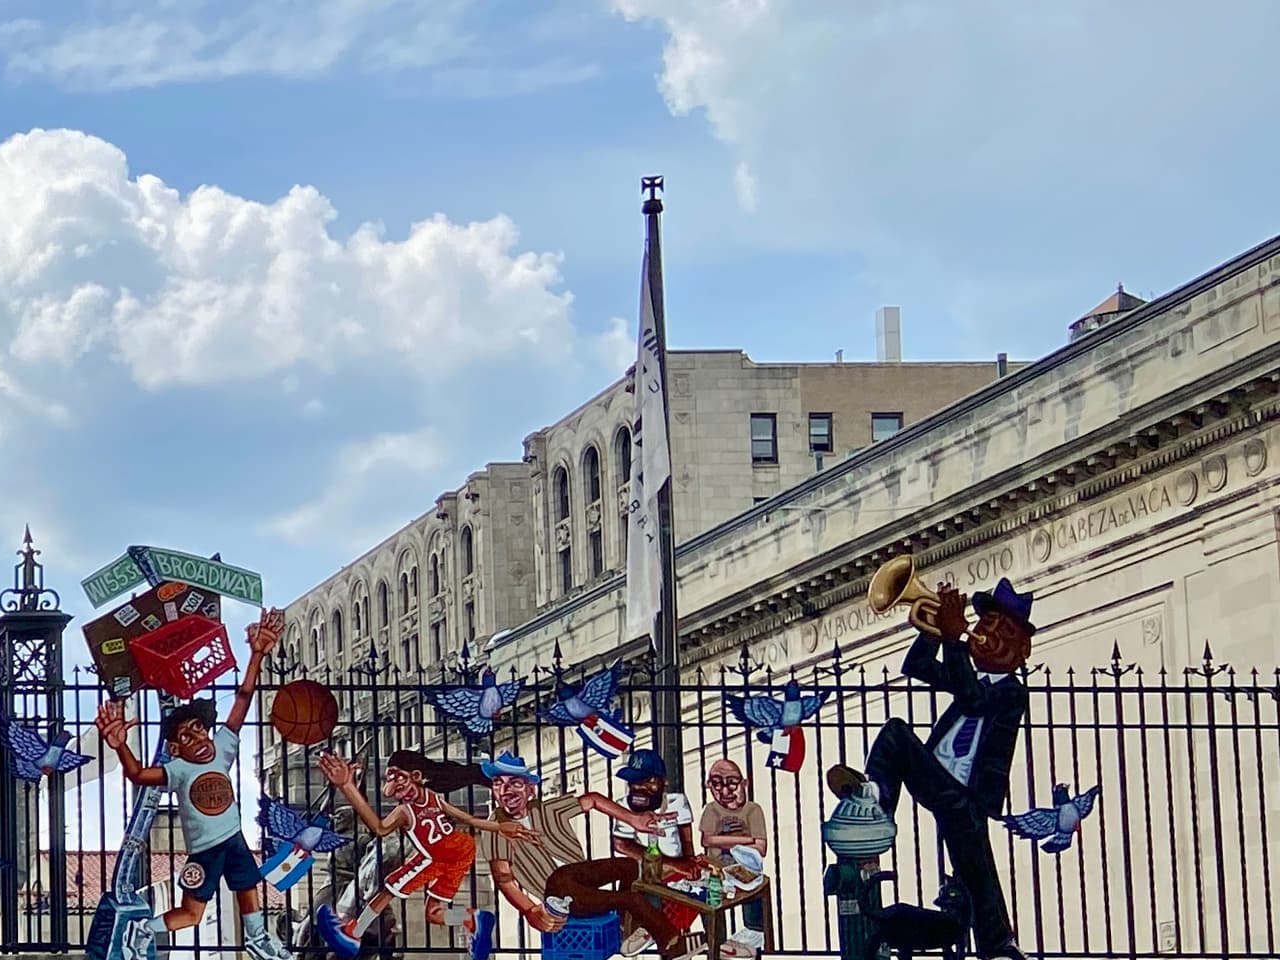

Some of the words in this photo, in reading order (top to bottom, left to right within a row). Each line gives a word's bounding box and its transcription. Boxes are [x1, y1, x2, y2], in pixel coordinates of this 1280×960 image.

[1056, 502, 1119, 549] CABEZA
[1128, 486, 1172, 520] VACA
[155, 553, 260, 600] BROADWAY
[968, 547, 1013, 586] SOTO
[421, 814, 453, 845] 26
